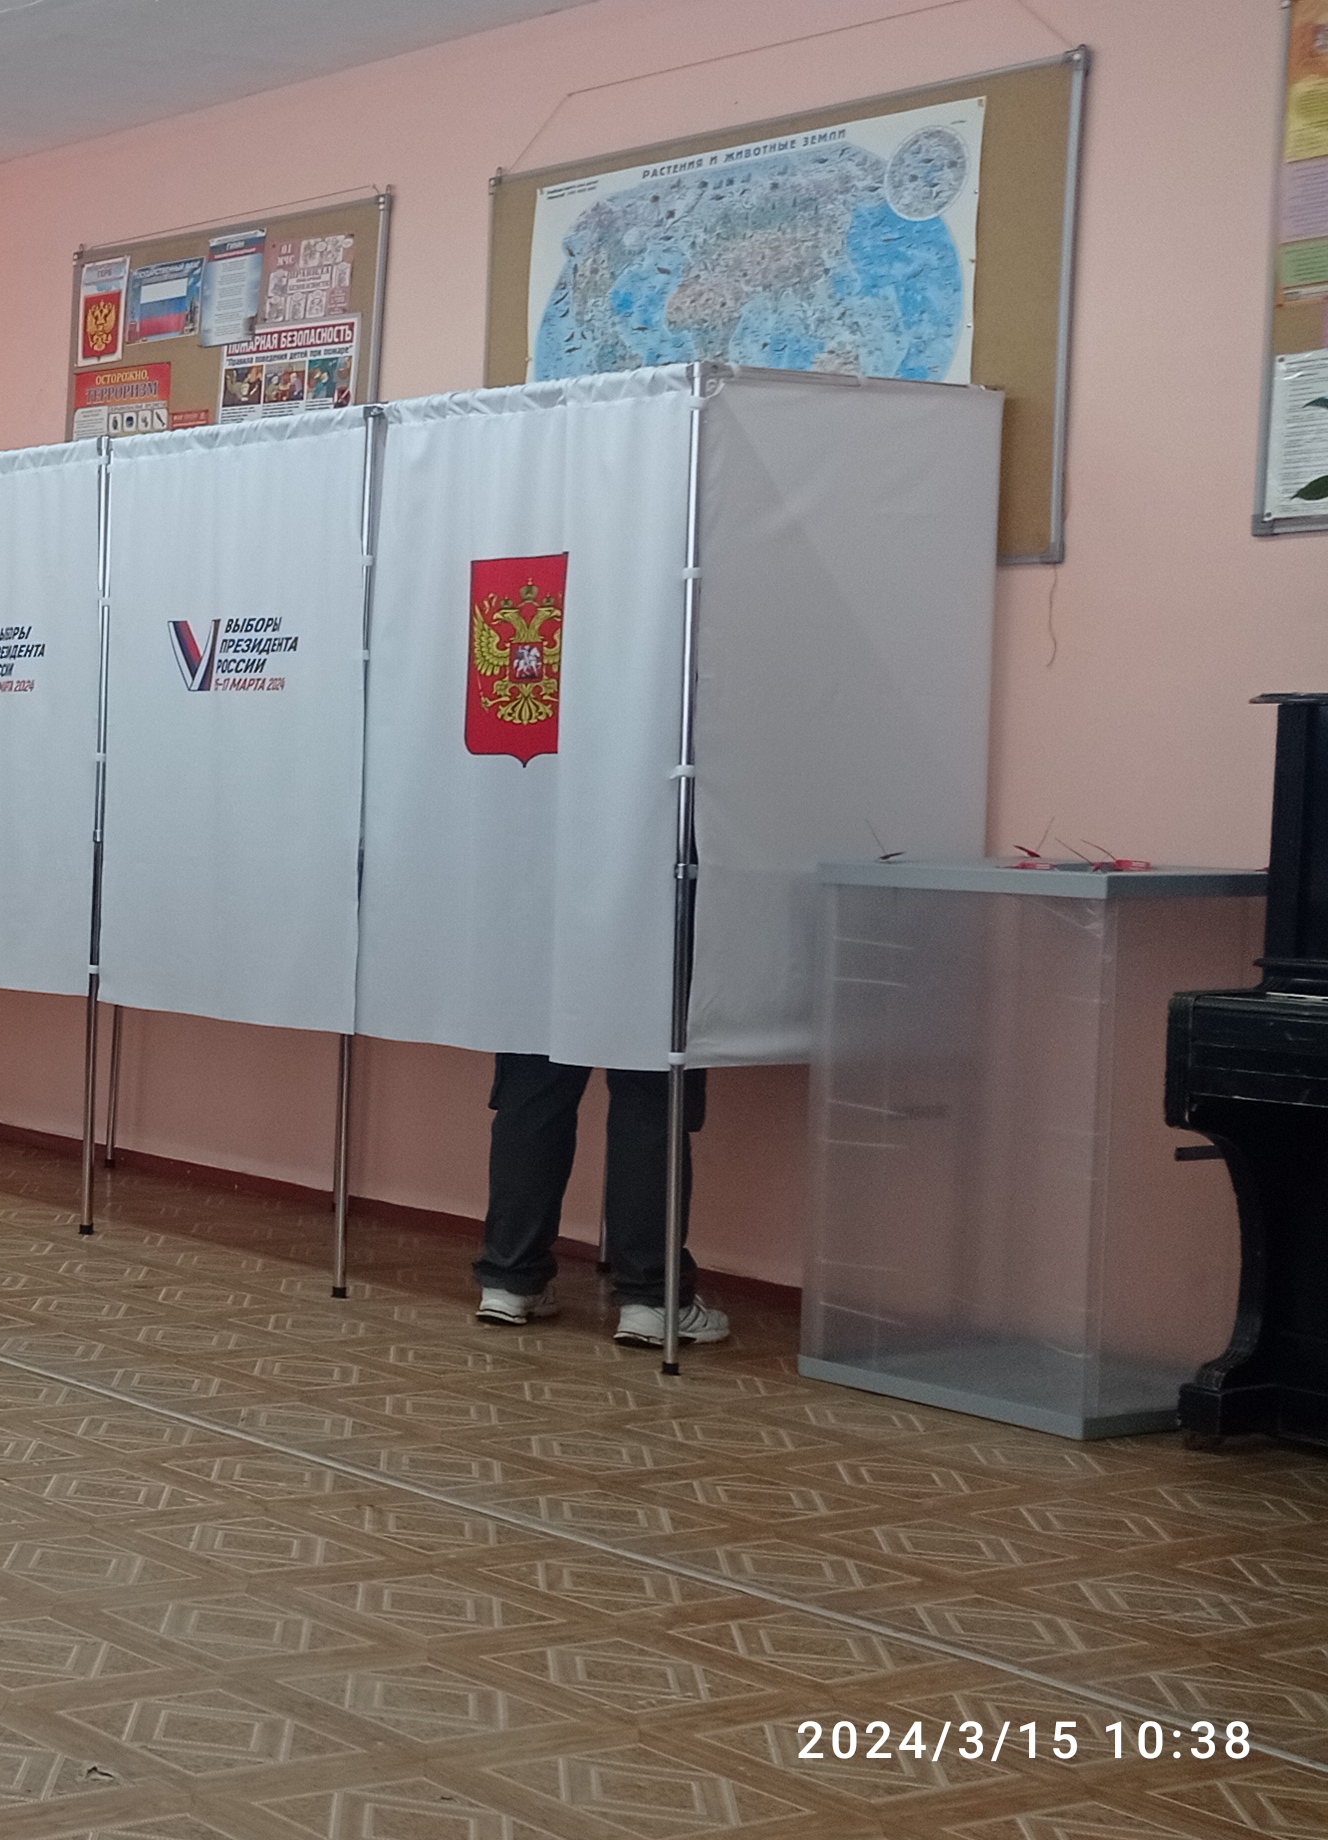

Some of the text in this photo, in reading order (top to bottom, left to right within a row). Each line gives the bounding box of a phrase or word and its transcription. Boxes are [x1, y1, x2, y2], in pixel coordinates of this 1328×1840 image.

[642, 129, 846, 179] РАСТЕНИЯ И ЖИВОТНЫЕ ЗЕМЛИ
[280, 325, 352, 349] БЕЗОПАСНОСТЬ
[95, 369, 149, 386] ОСТОРОЖНО,
[85, 380, 159, 404] ТЕРРОРИЗМ
[225, 617, 282, 633] ВЫБОРЫ
[219, 636, 299, 655] ПРЕЗИДЕНТА
[216, 658, 267, 673] РОССИИ
[229, 677, 266, 691] МАРТА
